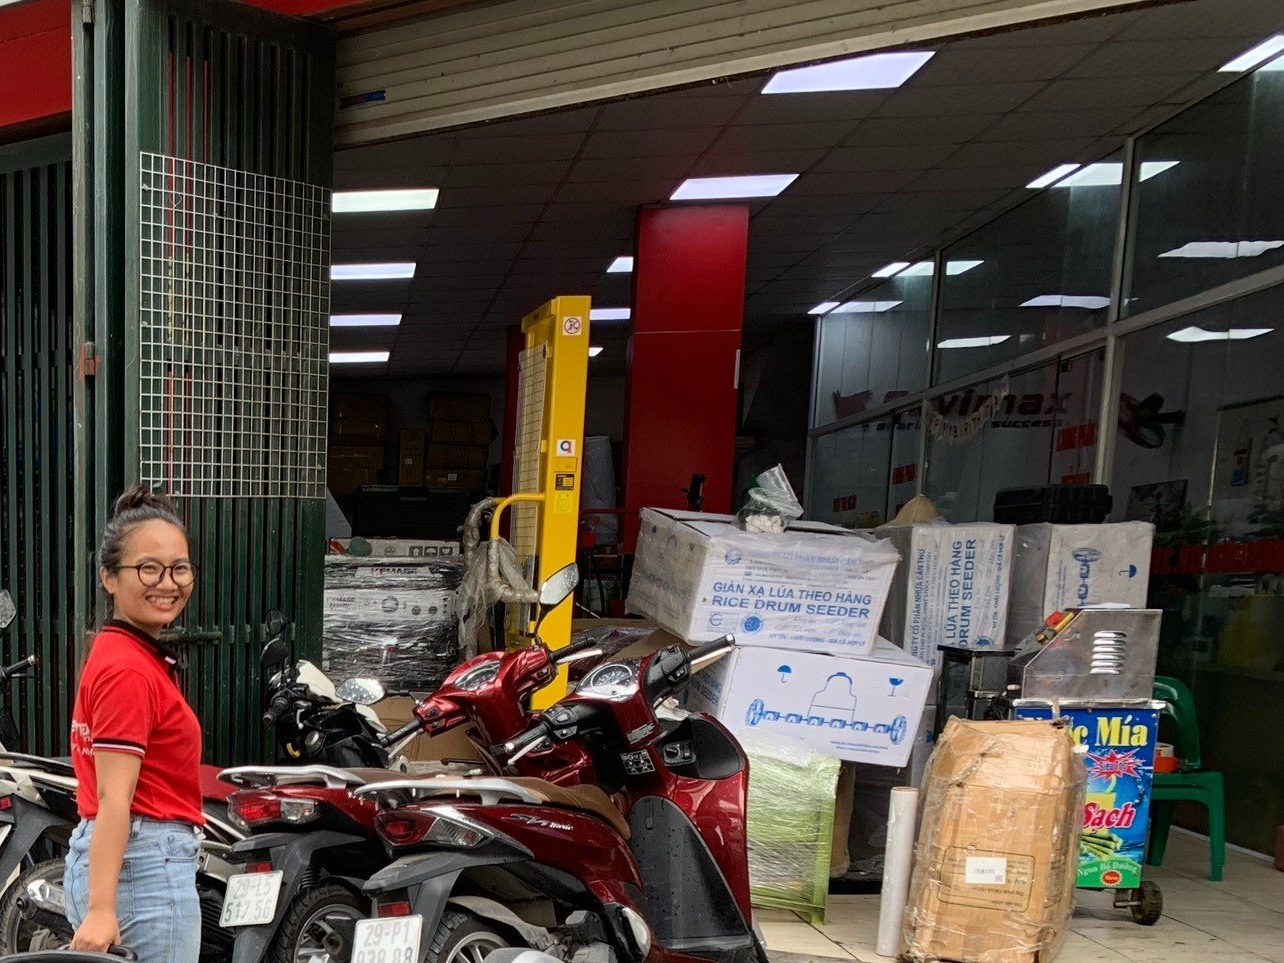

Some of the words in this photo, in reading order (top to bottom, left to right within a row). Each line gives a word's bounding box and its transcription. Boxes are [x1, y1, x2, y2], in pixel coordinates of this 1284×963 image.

[949, 540, 963, 576] HÀNG
[962, 539, 977, 601] SEEDER
[711, 595, 750, 609] RICE
[753, 598, 801, 613] DRUM
[805, 603, 871, 619] SEEDER
[713, 581, 745, 594] GIÀN
[748, 584, 765, 599] XẠ
[768, 584, 795, 600] LÚA
[798, 589, 833, 602] THEO
[835, 589, 873, 606] HÀNG
[947, 579, 960, 612] THEO
[943, 615, 957, 639] LÚA
[958, 605, 972, 647] DRUM
[1094, 714, 1148, 747] Mía
[1083, 801, 1137, 834] Sạch
[364, 920, 411, 947] 29-P1
